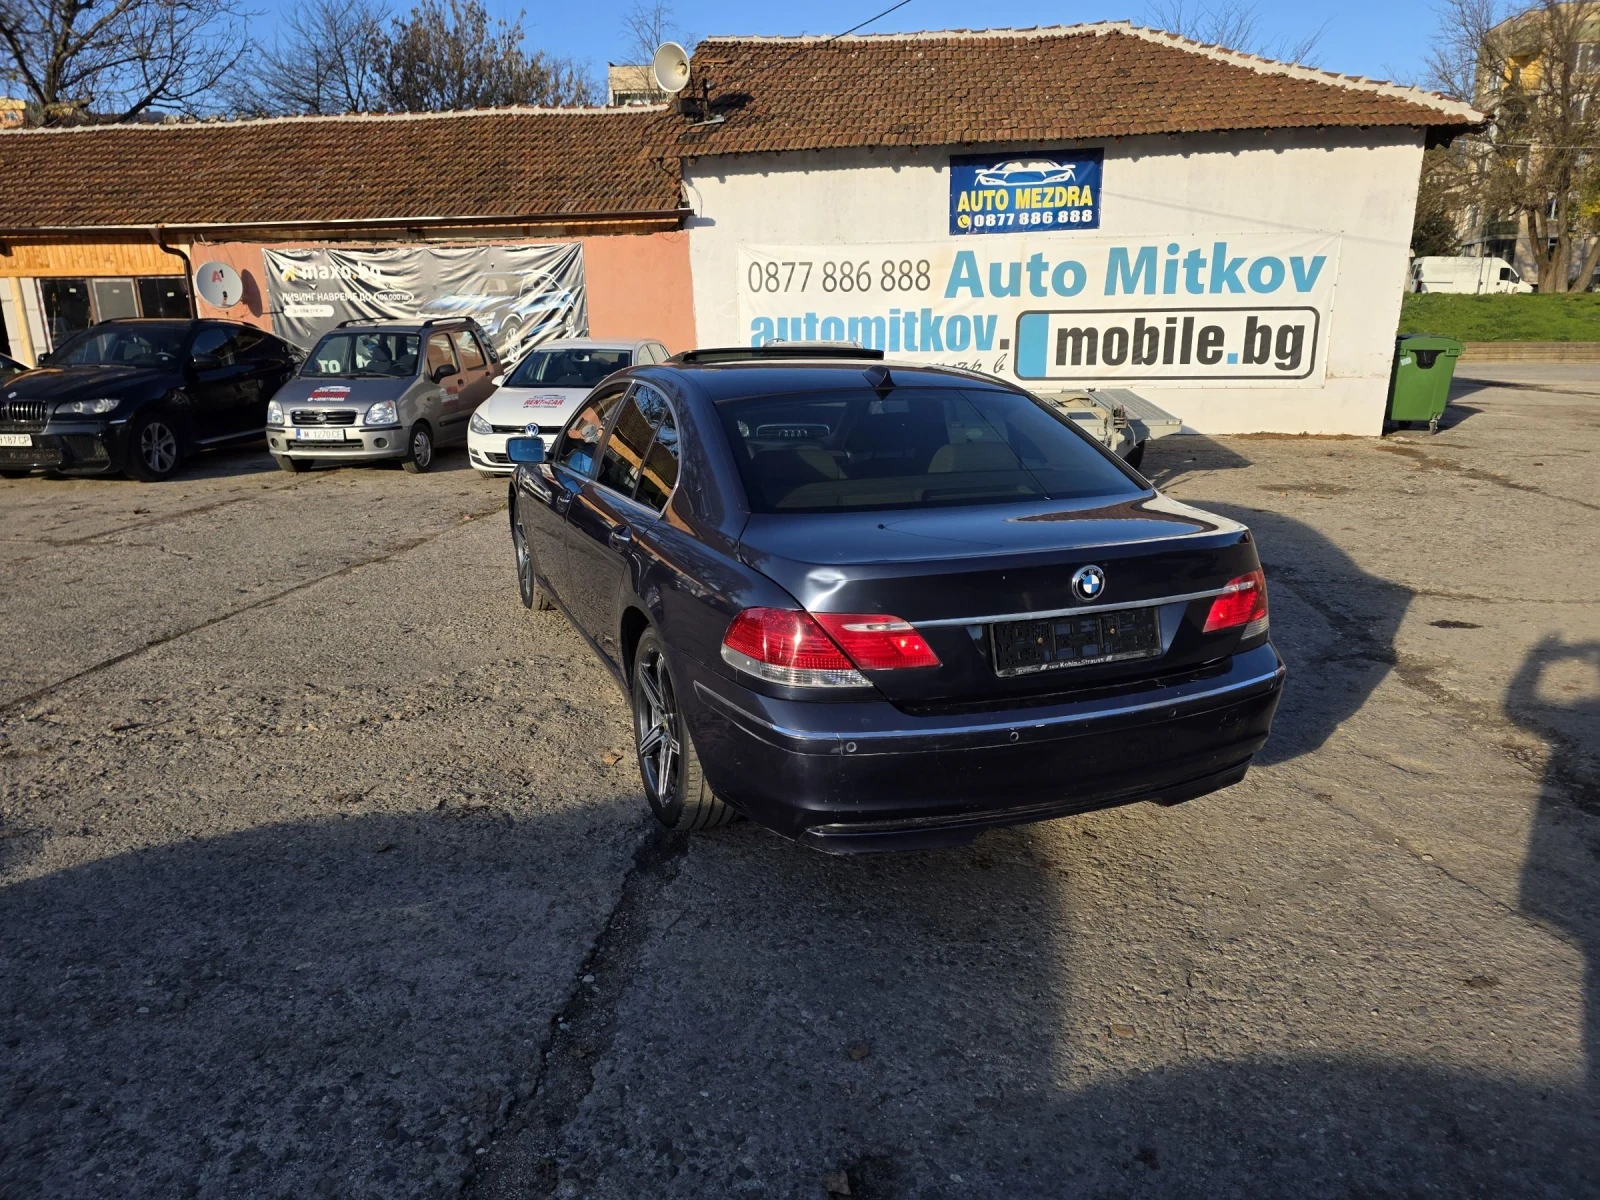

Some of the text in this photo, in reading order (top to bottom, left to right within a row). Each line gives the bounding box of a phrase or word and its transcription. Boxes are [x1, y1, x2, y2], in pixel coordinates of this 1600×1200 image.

[957, 185, 1093, 212] AUTO MEZDRA
[974, 209, 1093, 227] 0877 886 888
[748, 259, 931, 293] 0877 886 888
[944, 242, 1327, 298] Auto Mitkov
[1055, 316, 1305, 371] mobile.bg
